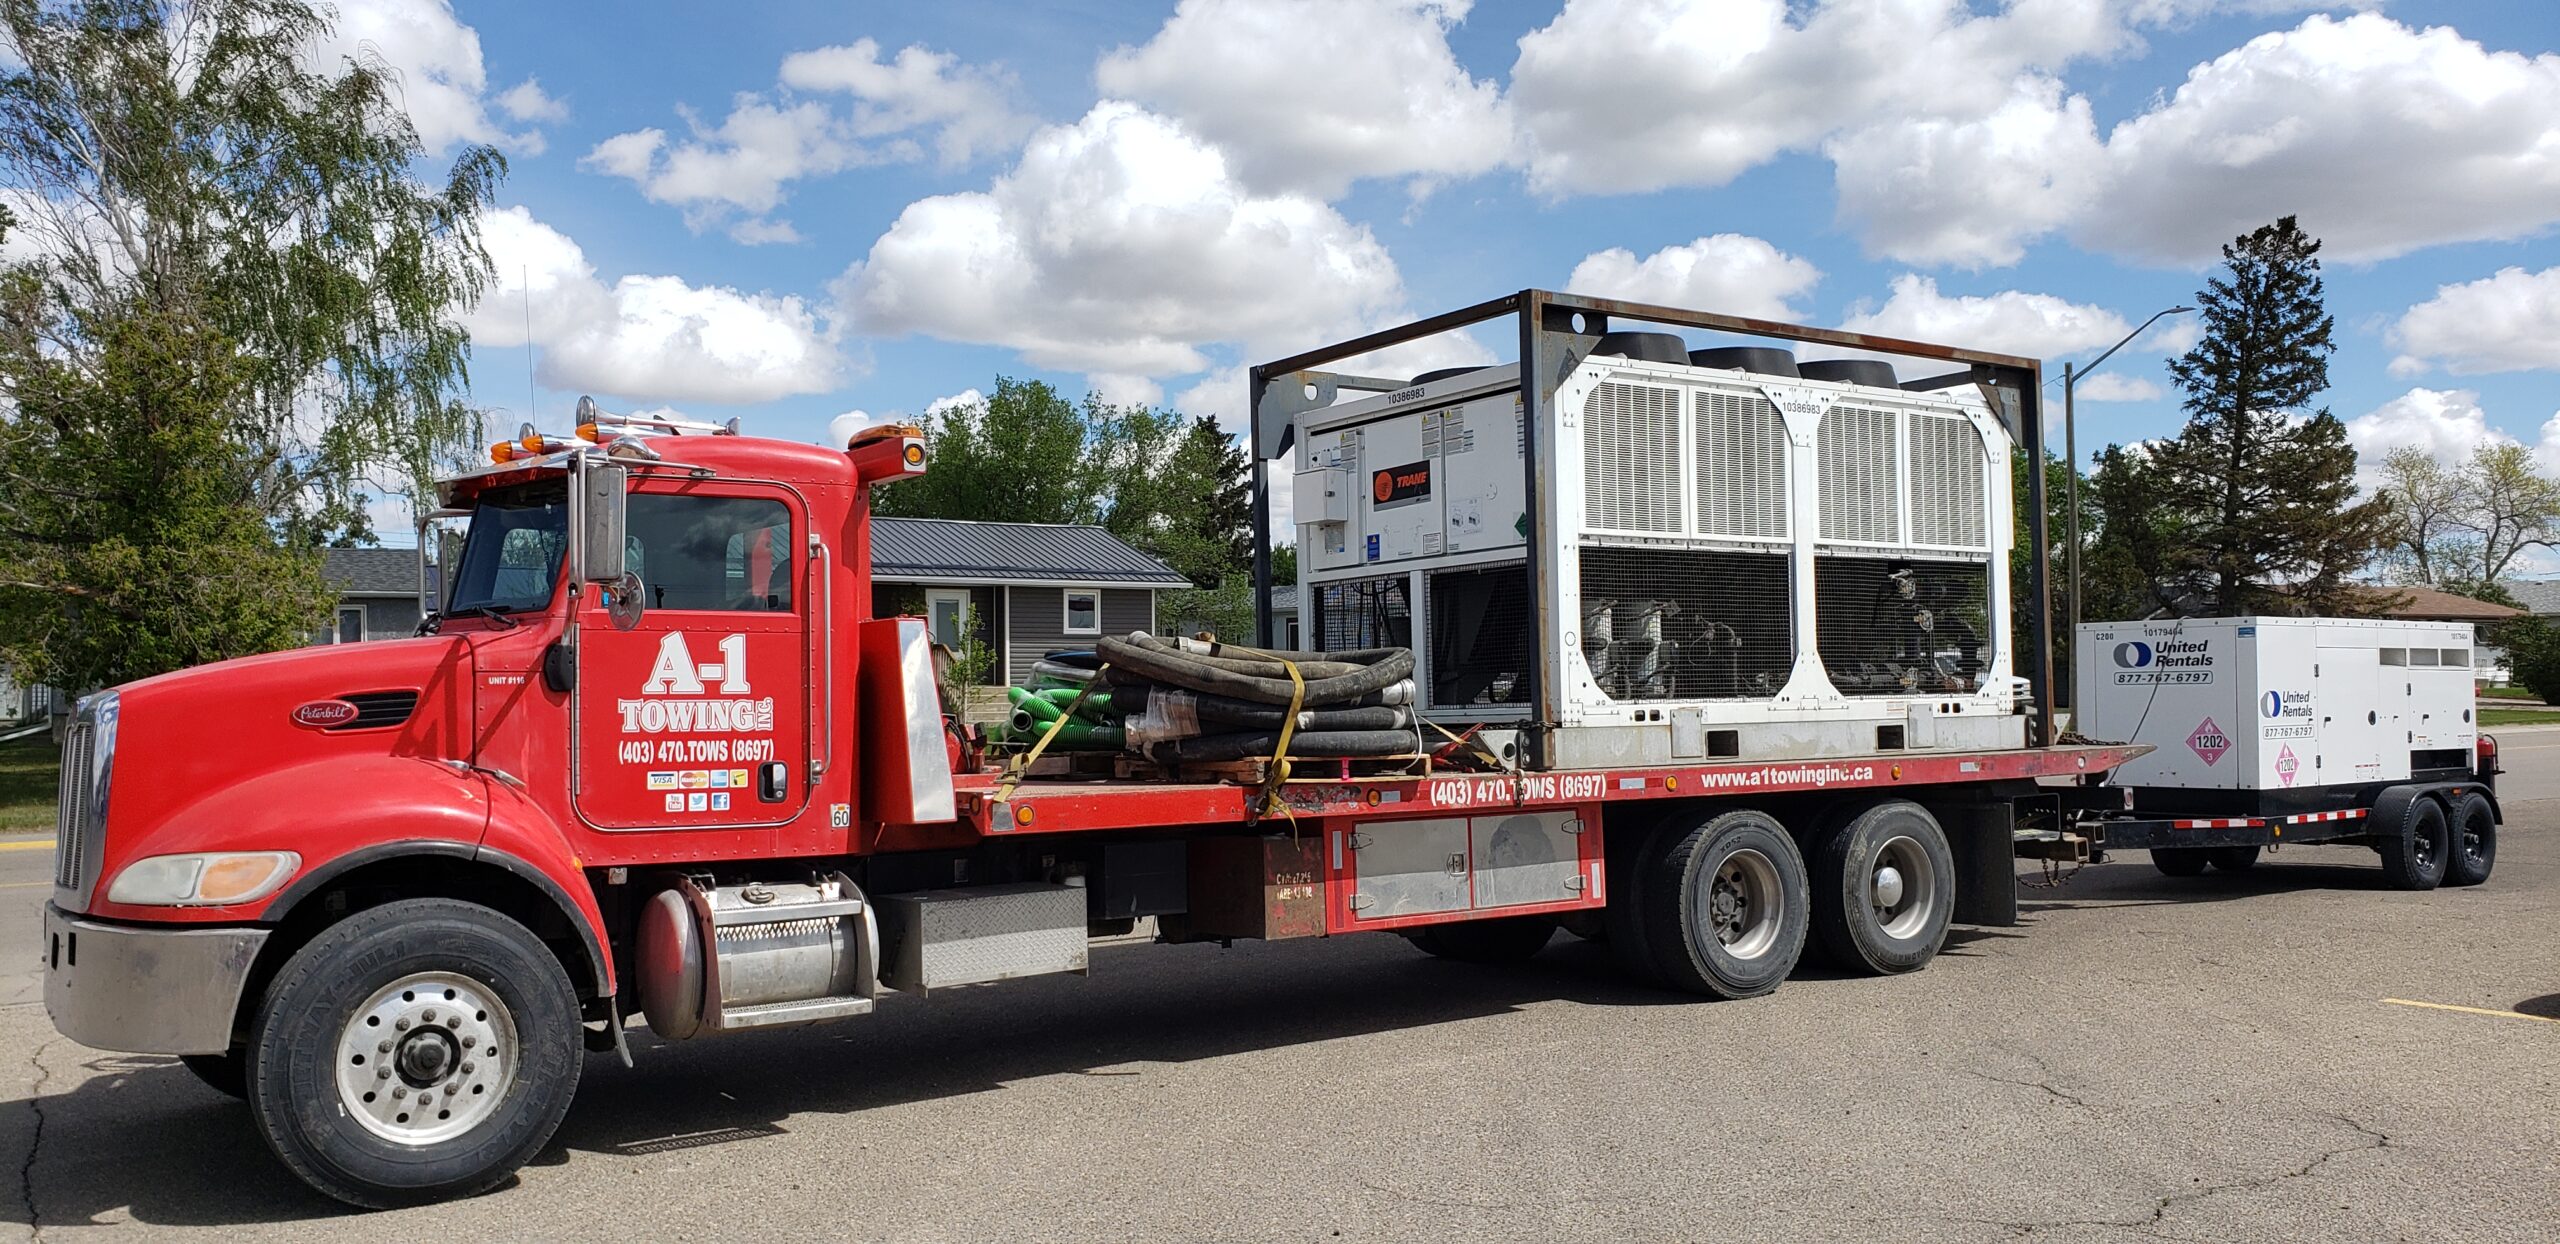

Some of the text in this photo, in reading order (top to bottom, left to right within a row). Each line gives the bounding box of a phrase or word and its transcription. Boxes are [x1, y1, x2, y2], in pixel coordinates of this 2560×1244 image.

[1388, 387, 1425, 405] 10386983
[1782, 401, 1821, 415] 10386983
[1396, 471, 1427, 488] TRANE
[2155, 639, 2209, 654] United
[643, 630, 750, 694] A-1
[2155, 653, 2213, 667] Rentals
[488, 676, 507, 684] UNIT
[2117, 672, 2209, 684] 877-767-6797
[2282, 690, 2310, 703] United
[300, 706, 350, 720] Peterbilt
[617, 698, 756, 732] TOWING
[2282, 704, 2313, 718] Rentals
[2264, 726, 2313, 738] 877-767-6797
[2197, 735, 2223, 748] 1202
[619, 738, 774, 765] (403) 470.TOWS (8697)
[2207, 752, 2213, 761] 3
[2280, 758, 2295, 772] 1202
[1701, 765, 1873, 788] www.a1towinginc.ca
[1430, 780, 1472, 807] (403)
[1560, 774, 1607, 800] (8697)
[834, 810, 849, 826] 60
